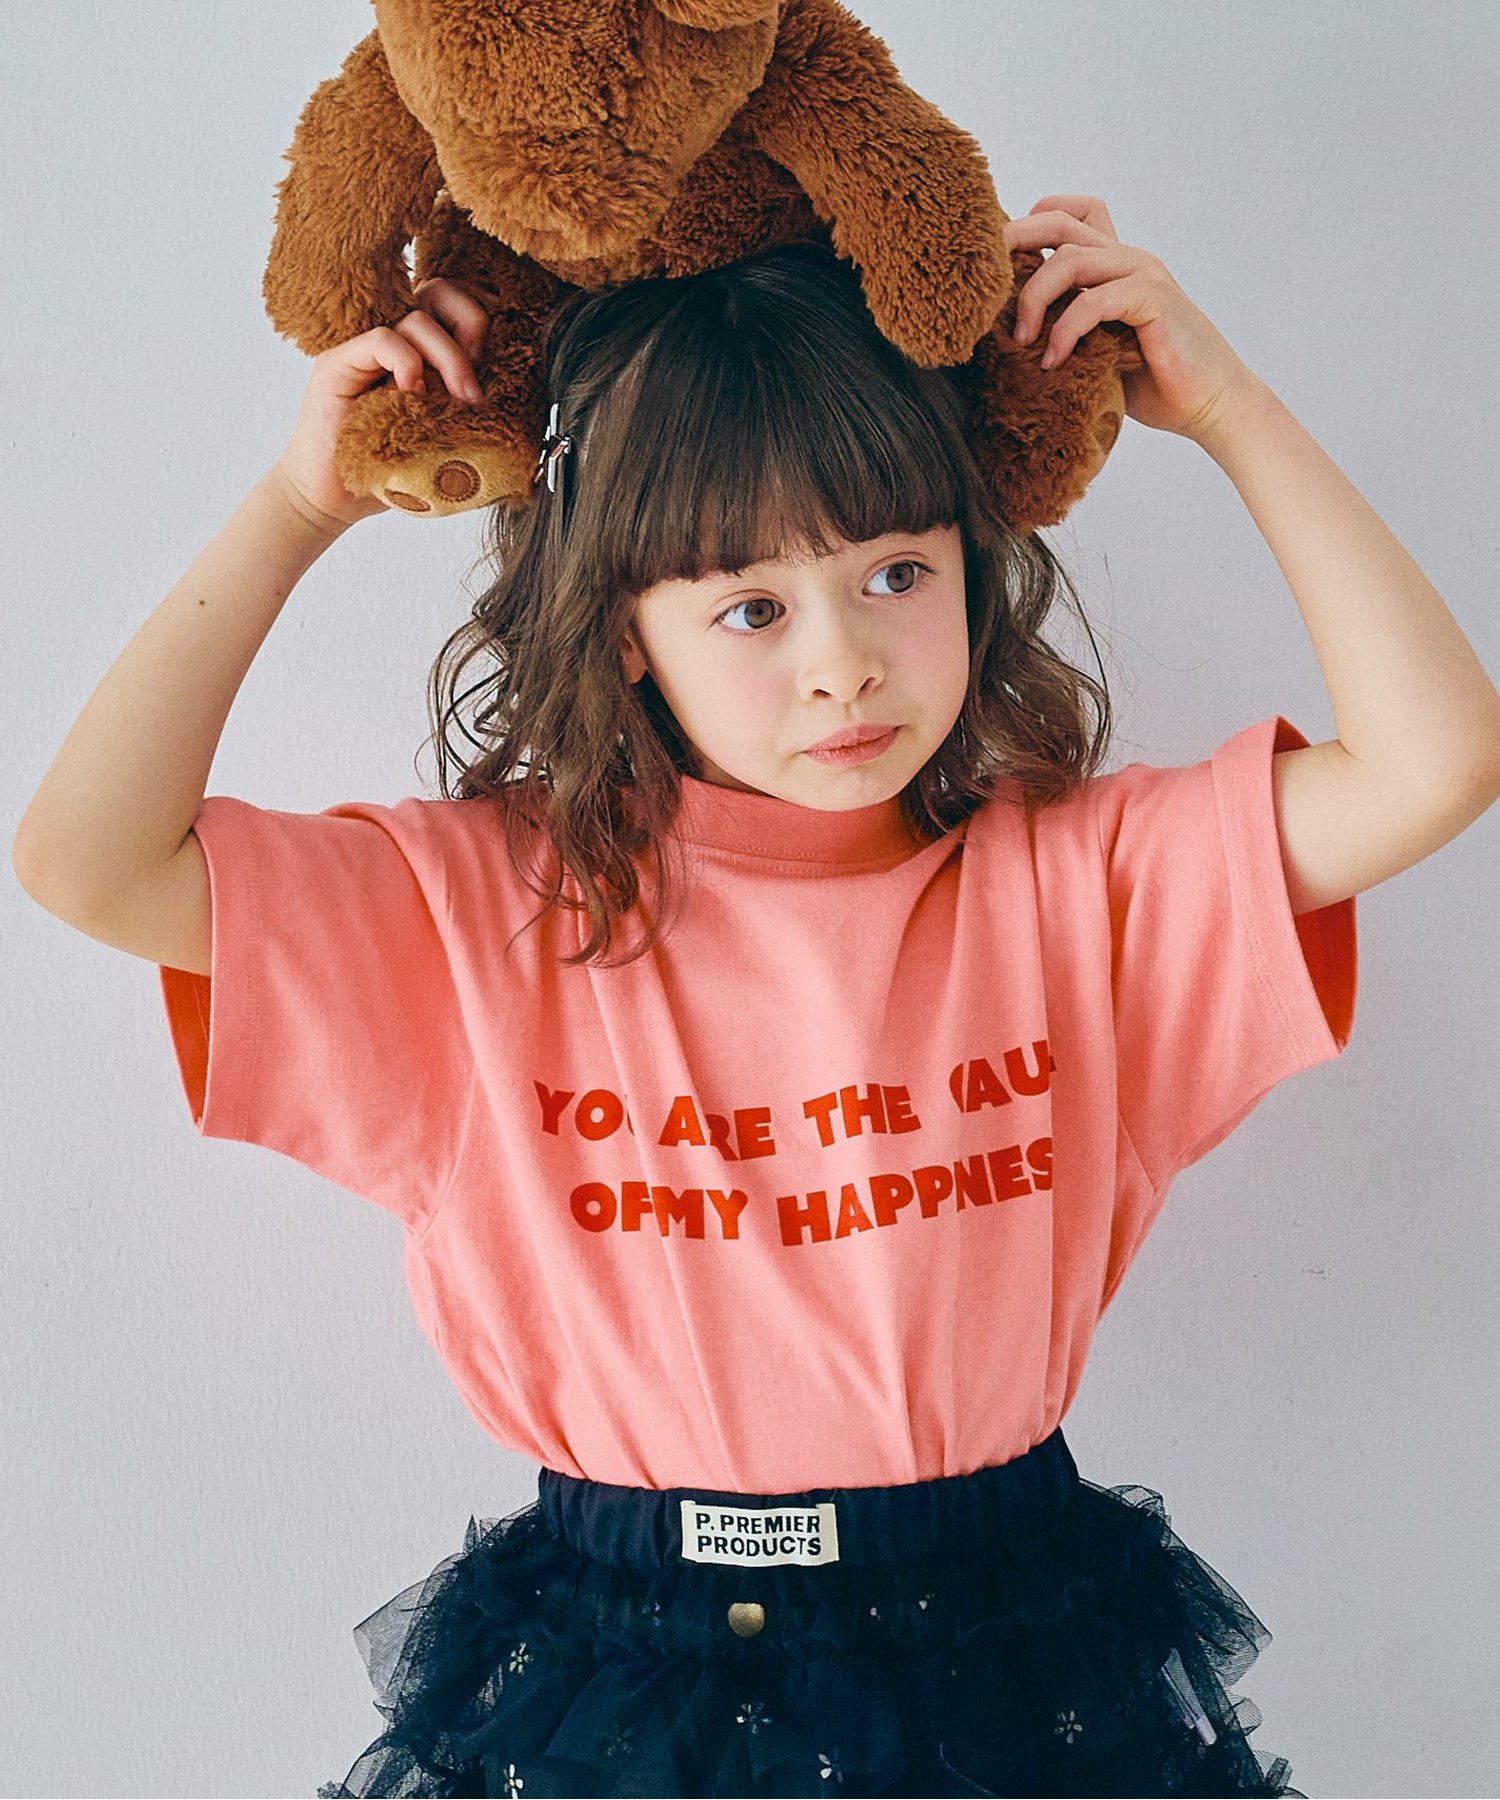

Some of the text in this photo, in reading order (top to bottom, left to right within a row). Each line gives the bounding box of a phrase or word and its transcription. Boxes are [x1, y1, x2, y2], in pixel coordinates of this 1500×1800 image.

[533, 1079, 635, 1141] YO
[658, 1095, 776, 1162] ARE
[804, 1083, 922, 1148] THE
[570, 1181, 654, 1233] OF
[651, 1186, 749, 1240] MY
[695, 1512, 820, 1534] P. PREMIER
[697, 1535, 822, 1557] PRODUCTS
